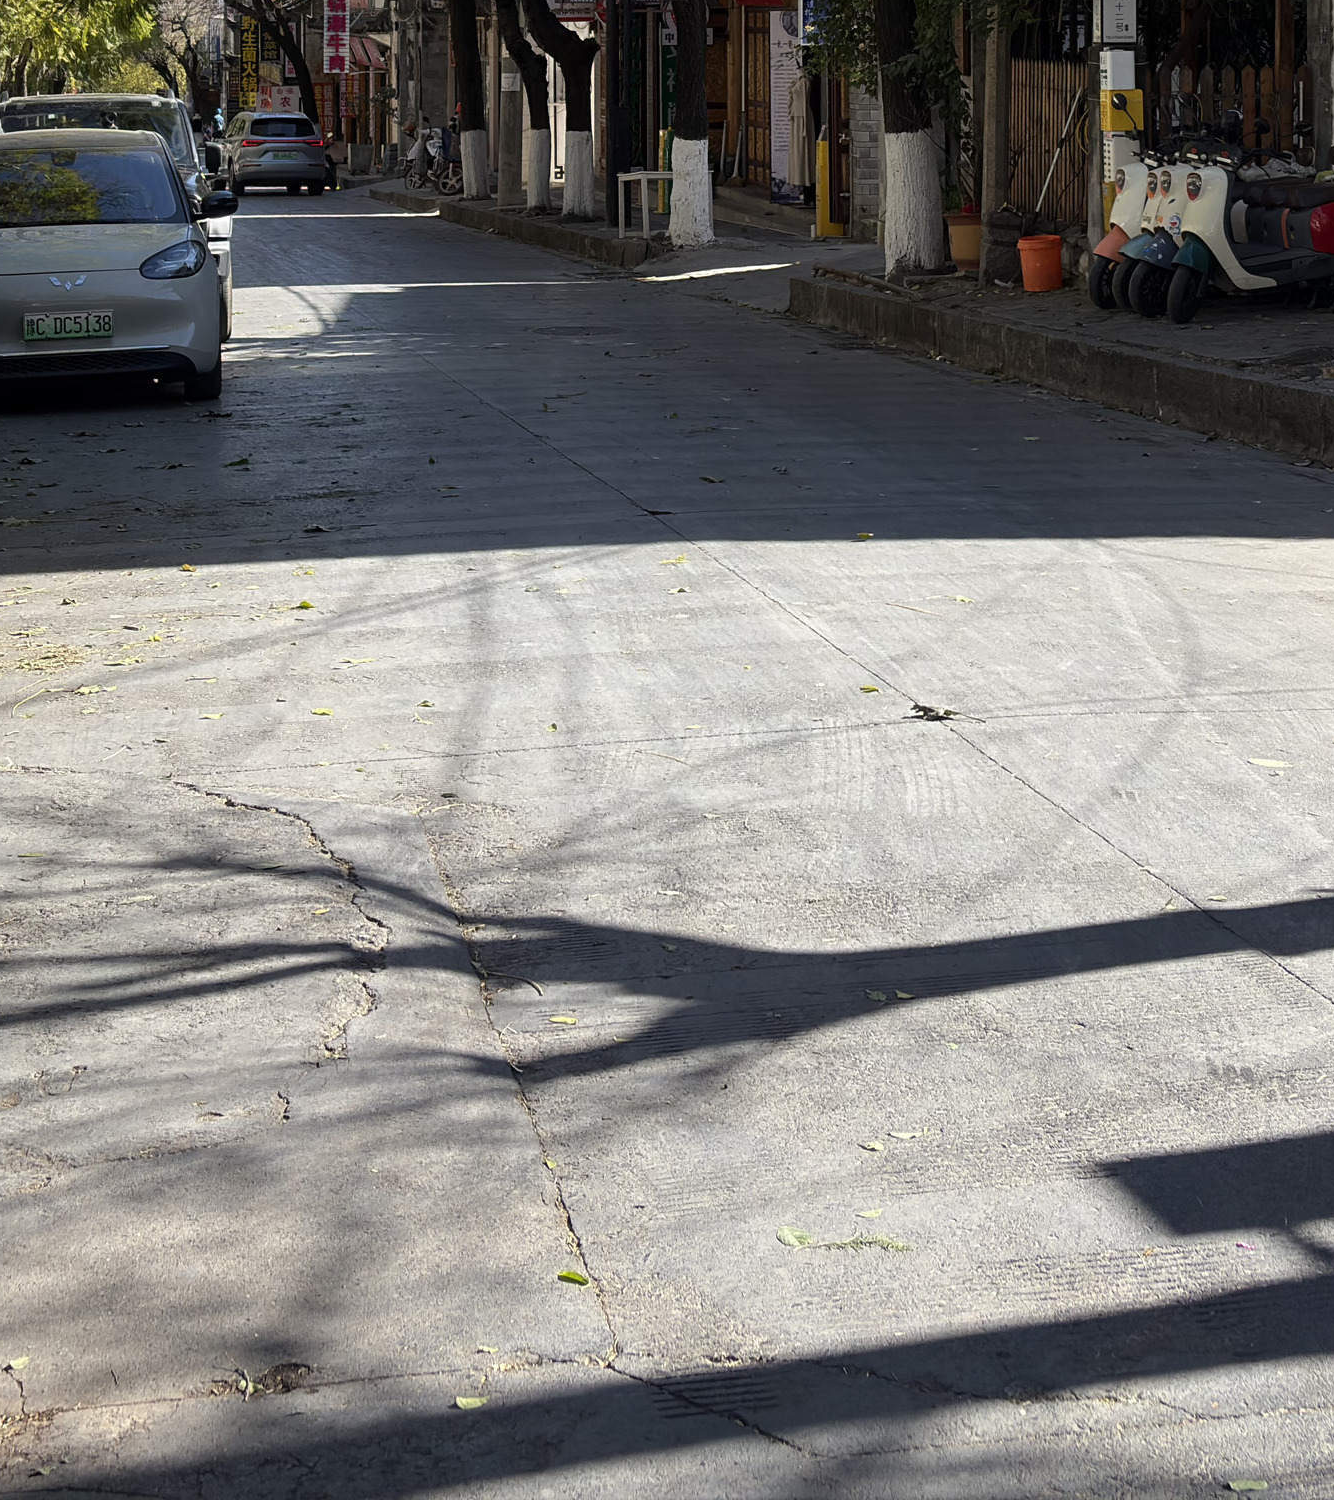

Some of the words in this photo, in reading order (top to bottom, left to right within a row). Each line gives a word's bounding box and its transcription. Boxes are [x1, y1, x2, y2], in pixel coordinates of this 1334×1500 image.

[240, 14, 259, 92] 野生菌火锅
